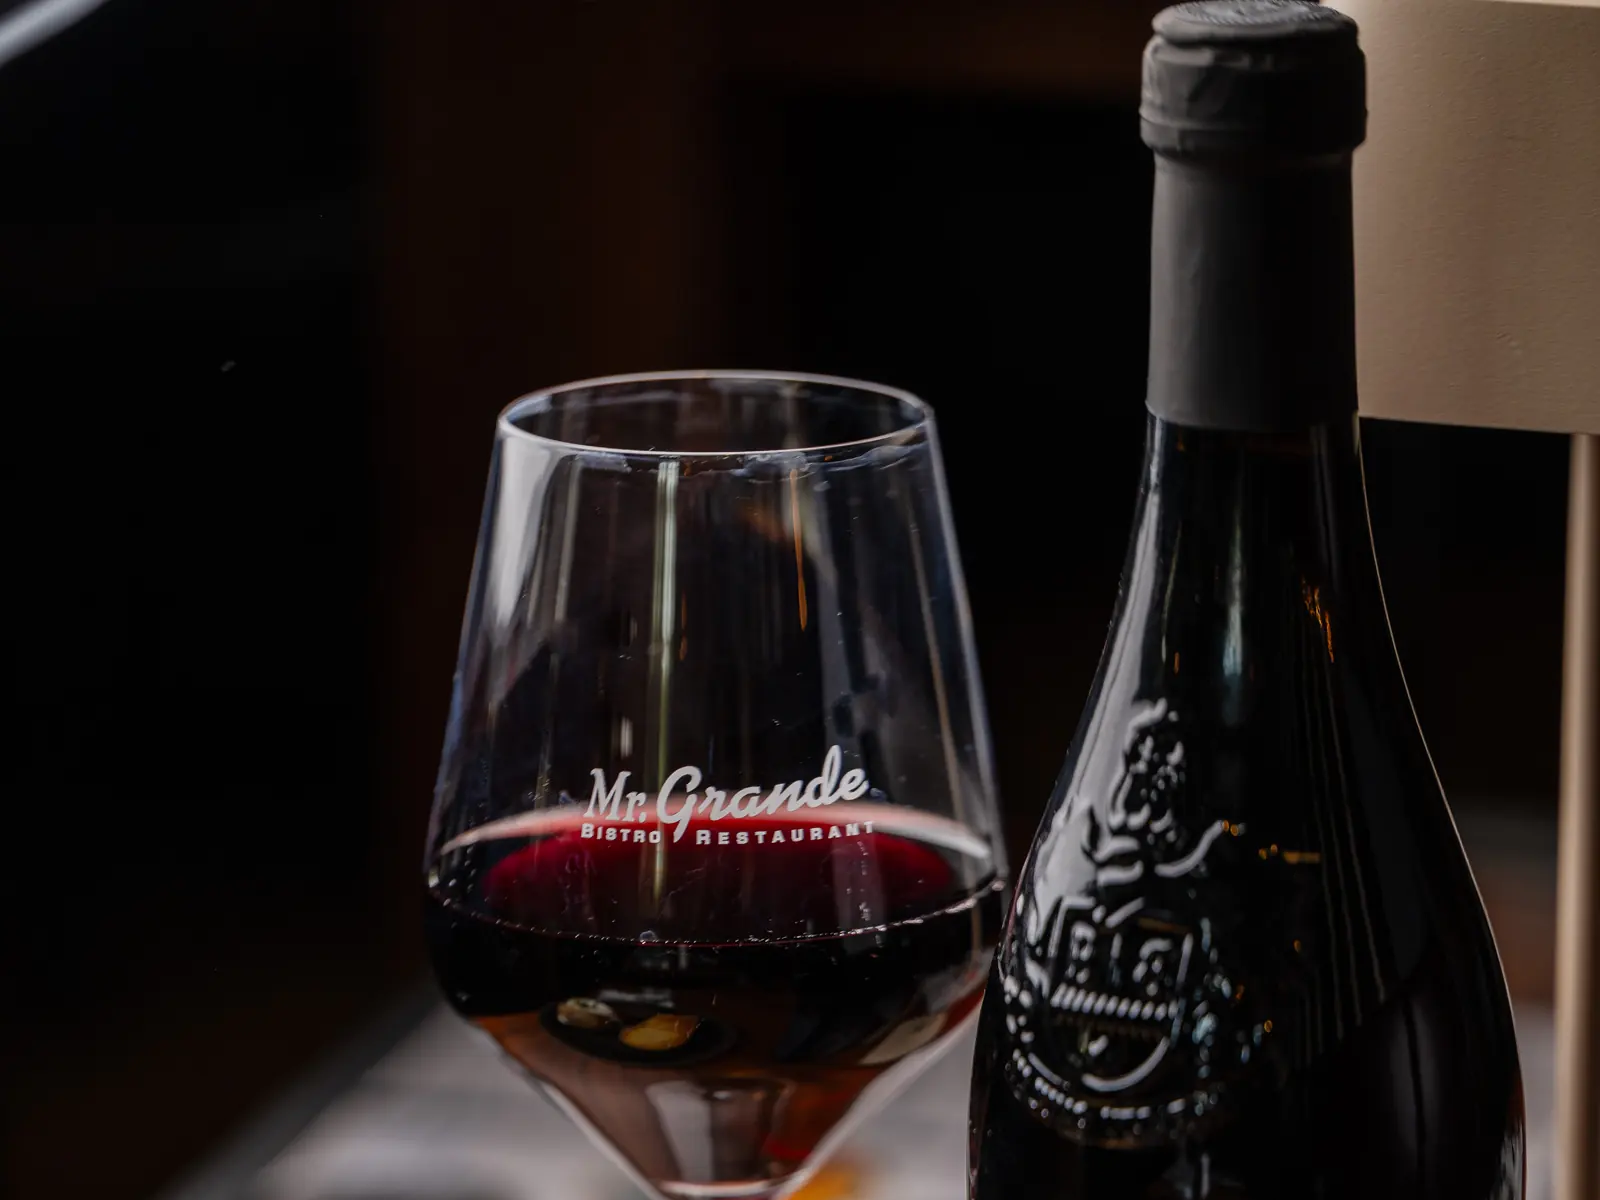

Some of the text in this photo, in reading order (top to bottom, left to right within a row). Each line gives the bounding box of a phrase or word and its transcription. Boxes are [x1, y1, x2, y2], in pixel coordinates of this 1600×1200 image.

[583, 744, 869, 842] Mr. Grande
[580, 820, 875, 845] BISTRO RESTAURANT
